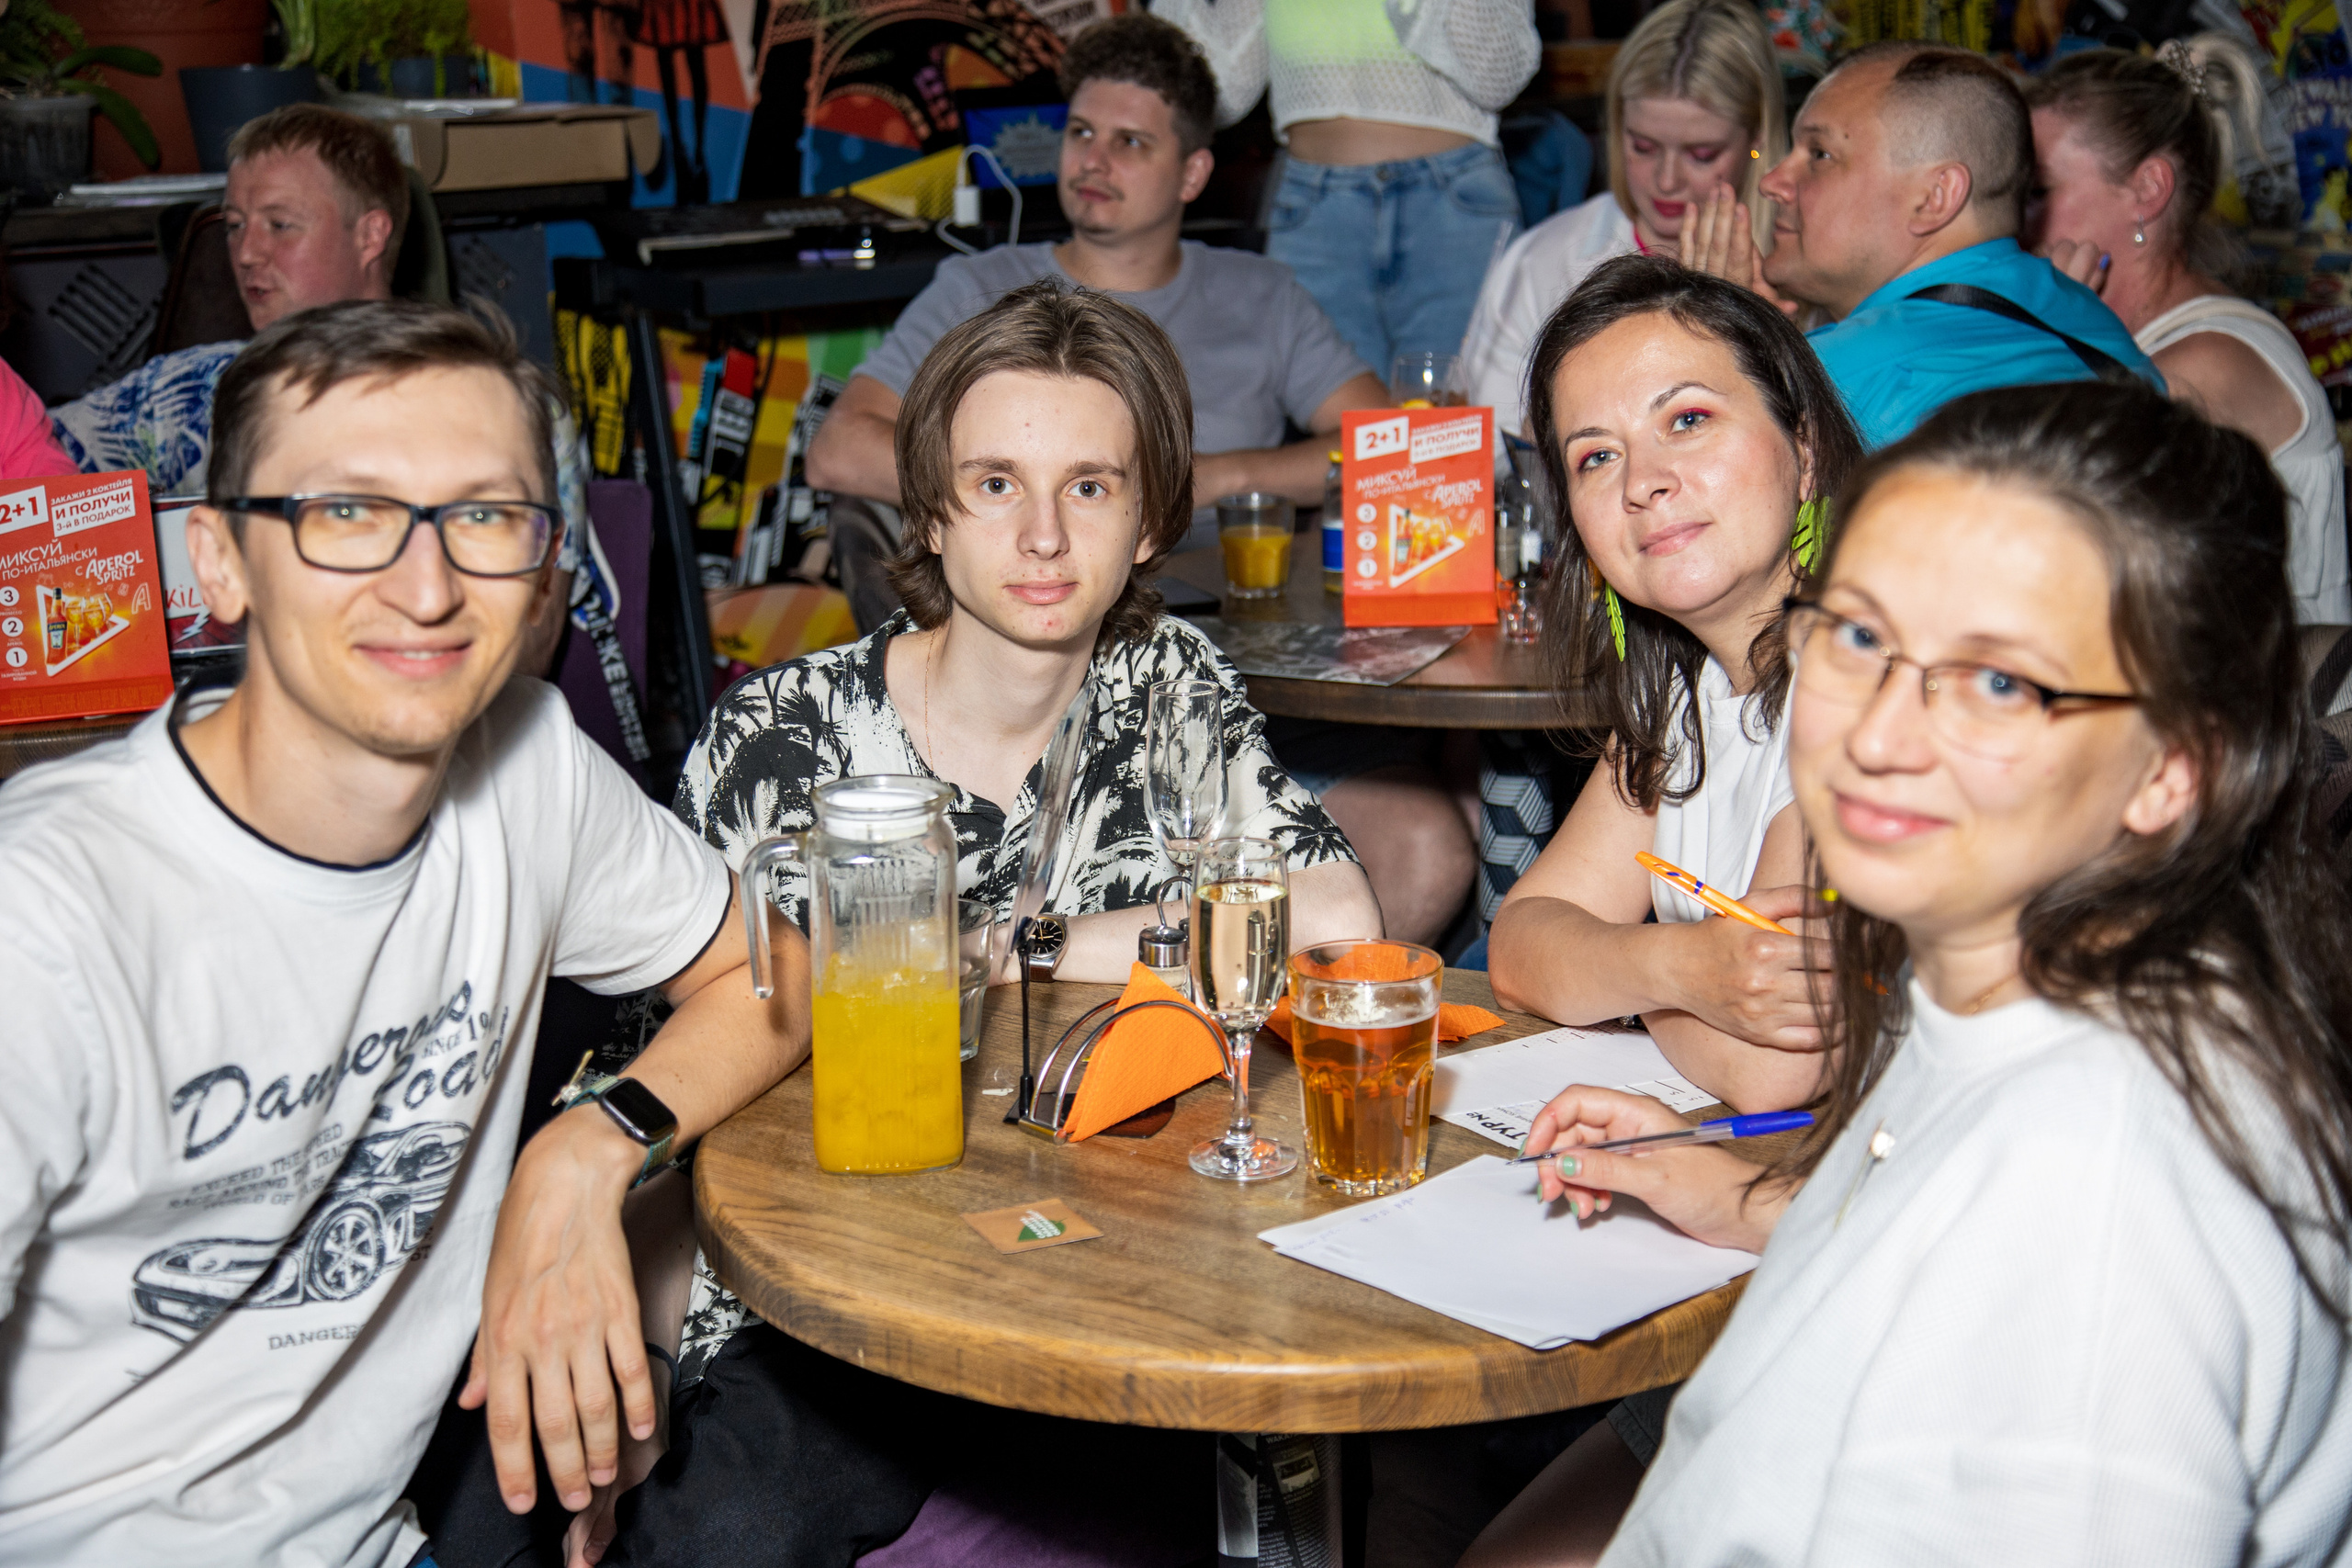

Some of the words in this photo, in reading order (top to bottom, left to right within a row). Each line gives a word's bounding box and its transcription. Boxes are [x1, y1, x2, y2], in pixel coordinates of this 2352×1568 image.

[1365, 427, 1400, 449] 2+1
[1415, 439, 1422, 447] И
[1427, 427, 1479, 446] ПОЛУЧИ
[1356, 464, 1417, 491] МИКСУЙ
[51, 491, 85, 505] ЗАКАЖИ
[92, 478, 132, 495] КОКТЕЙЛЯ
[0, 496, 39, 524] 2+1
[55, 509, 66, 520] И
[69, 491, 130, 517] ПОЛУЧИ
[56, 520, 72, 531] 3-й
[74, 518, 80, 526] В
[82, 505, 130, 525] ПОДАРОК
[2, 547, 97, 581] ПО-ИТАЛЬЯНСКИ
[85, 549, 143, 579] APEROL
[4, 590, 14, 603] 3
[165, 584, 209, 610] KiL
[8, 621, 18, 633] 2
[14, 651, 19, 663] 1
[271, 1151, 301, 1176] THE
[270, 1193, 295, 1206] OF
